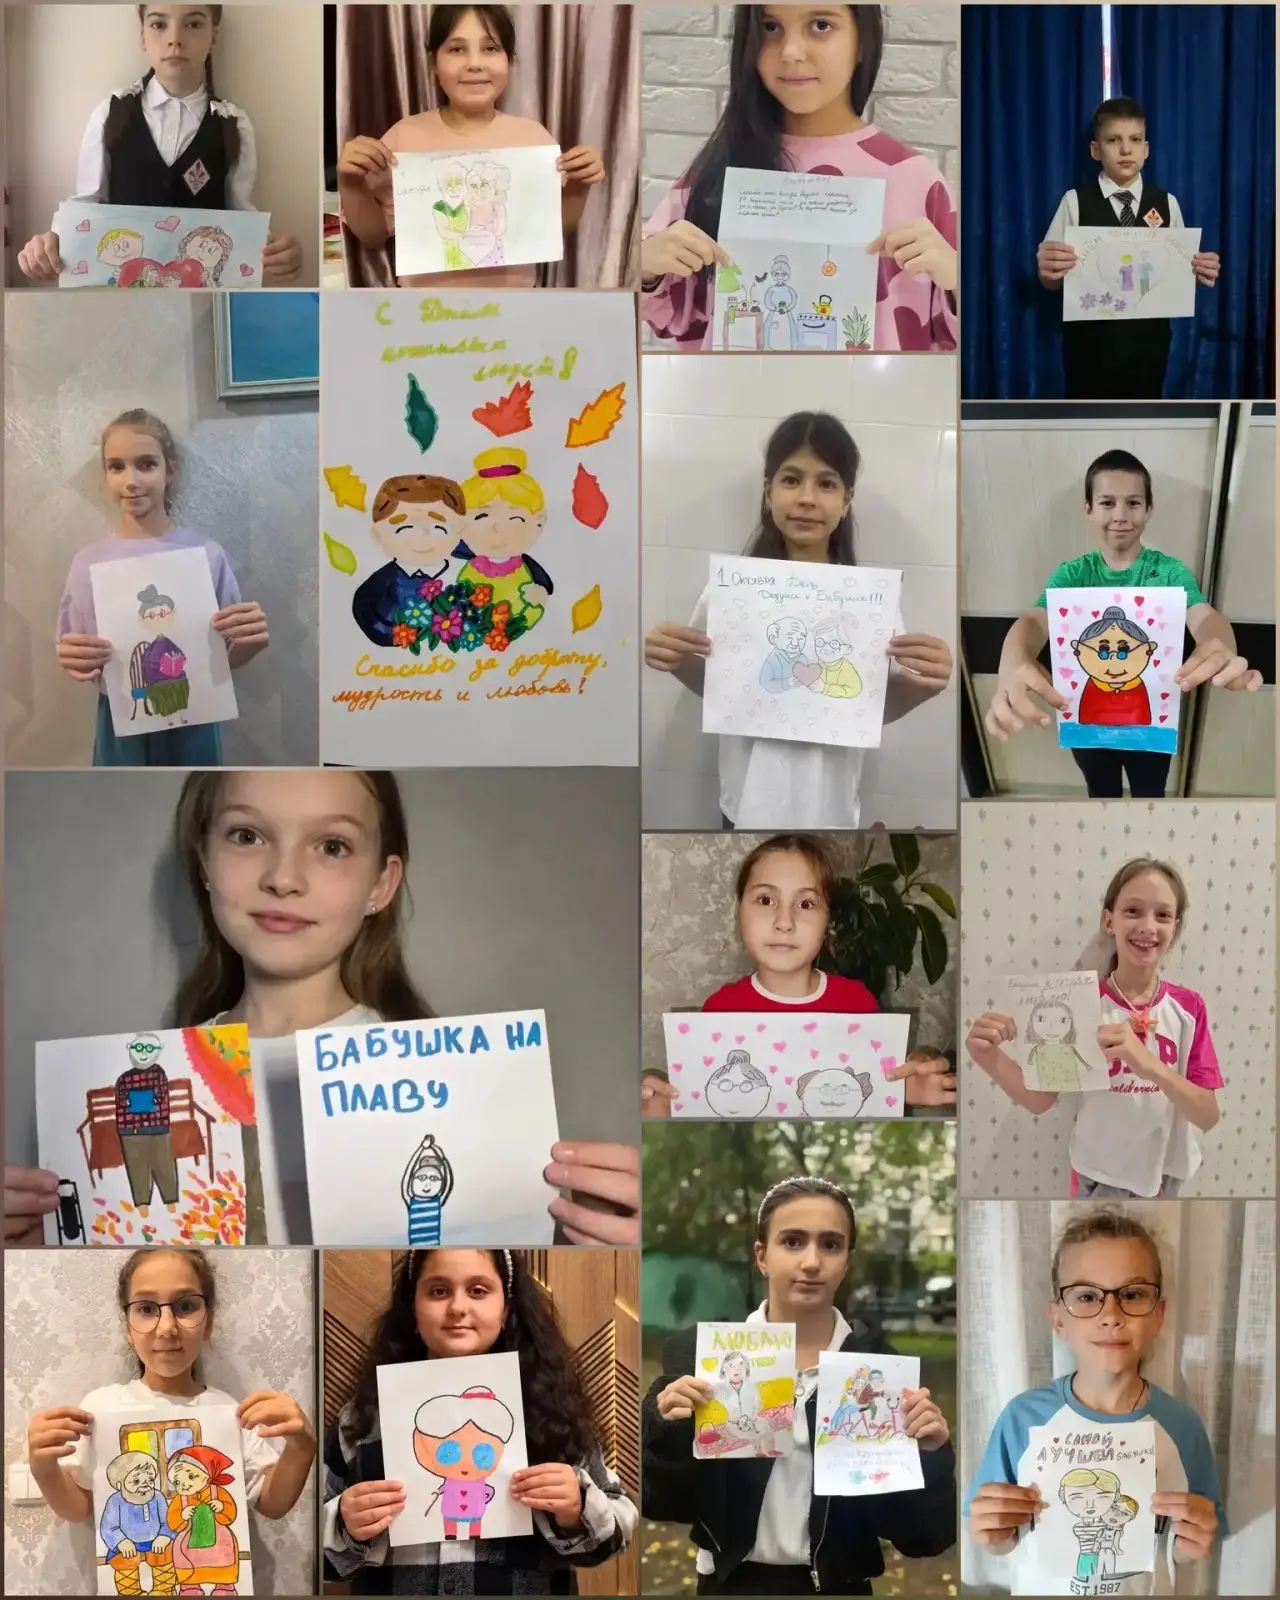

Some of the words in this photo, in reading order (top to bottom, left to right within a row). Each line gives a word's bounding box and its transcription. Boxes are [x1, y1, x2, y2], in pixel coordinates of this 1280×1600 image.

[375, 300, 392, 325] С
[717, 566, 730, 587] 1
[355, 653, 457, 678] Спасибо
[469, 656, 499, 682] за
[332, 687, 444, 712] мудрость
[456, 690, 471, 701] и
[314, 1024, 491, 1071] БАБУШКА
[505, 1021, 542, 1050] НА
[321, 1078, 449, 1117] ПЛАВУ
